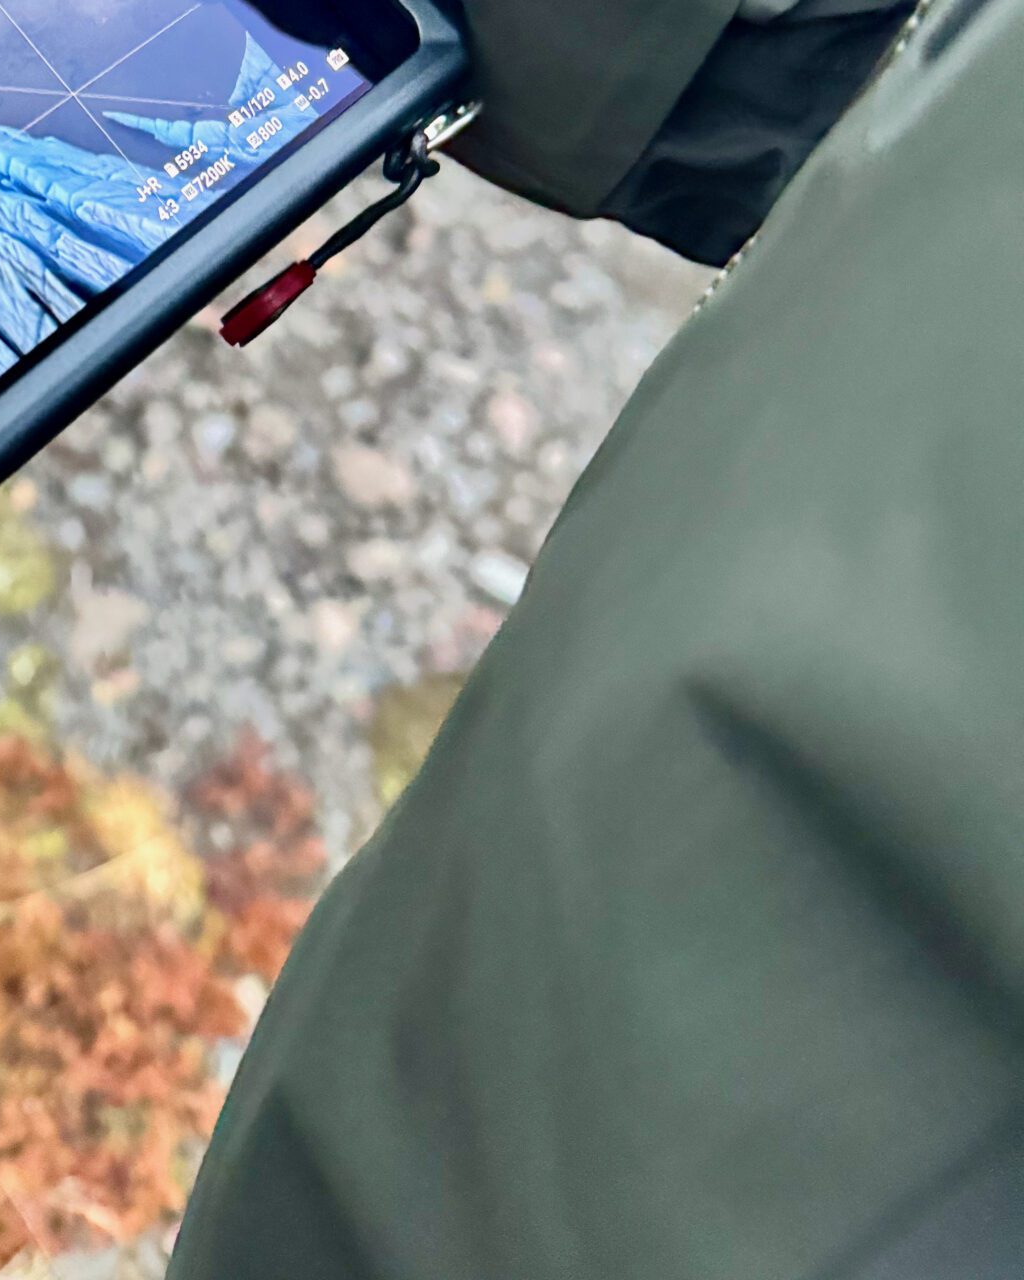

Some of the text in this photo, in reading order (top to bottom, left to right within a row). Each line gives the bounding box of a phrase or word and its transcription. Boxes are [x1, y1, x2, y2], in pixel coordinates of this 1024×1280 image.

[288, 61, 309, 84] 4.0
[239, 87, 276, 120] 1/120
[308, 78, 330, 103] -0.7
[258, 116, 283, 142] 800
[136, 177, 162, 203] J+R
[175, 140, 208, 171] 5934
[192, 155, 235, 193] 7200K
[157, 198, 180, 221] 4:3
